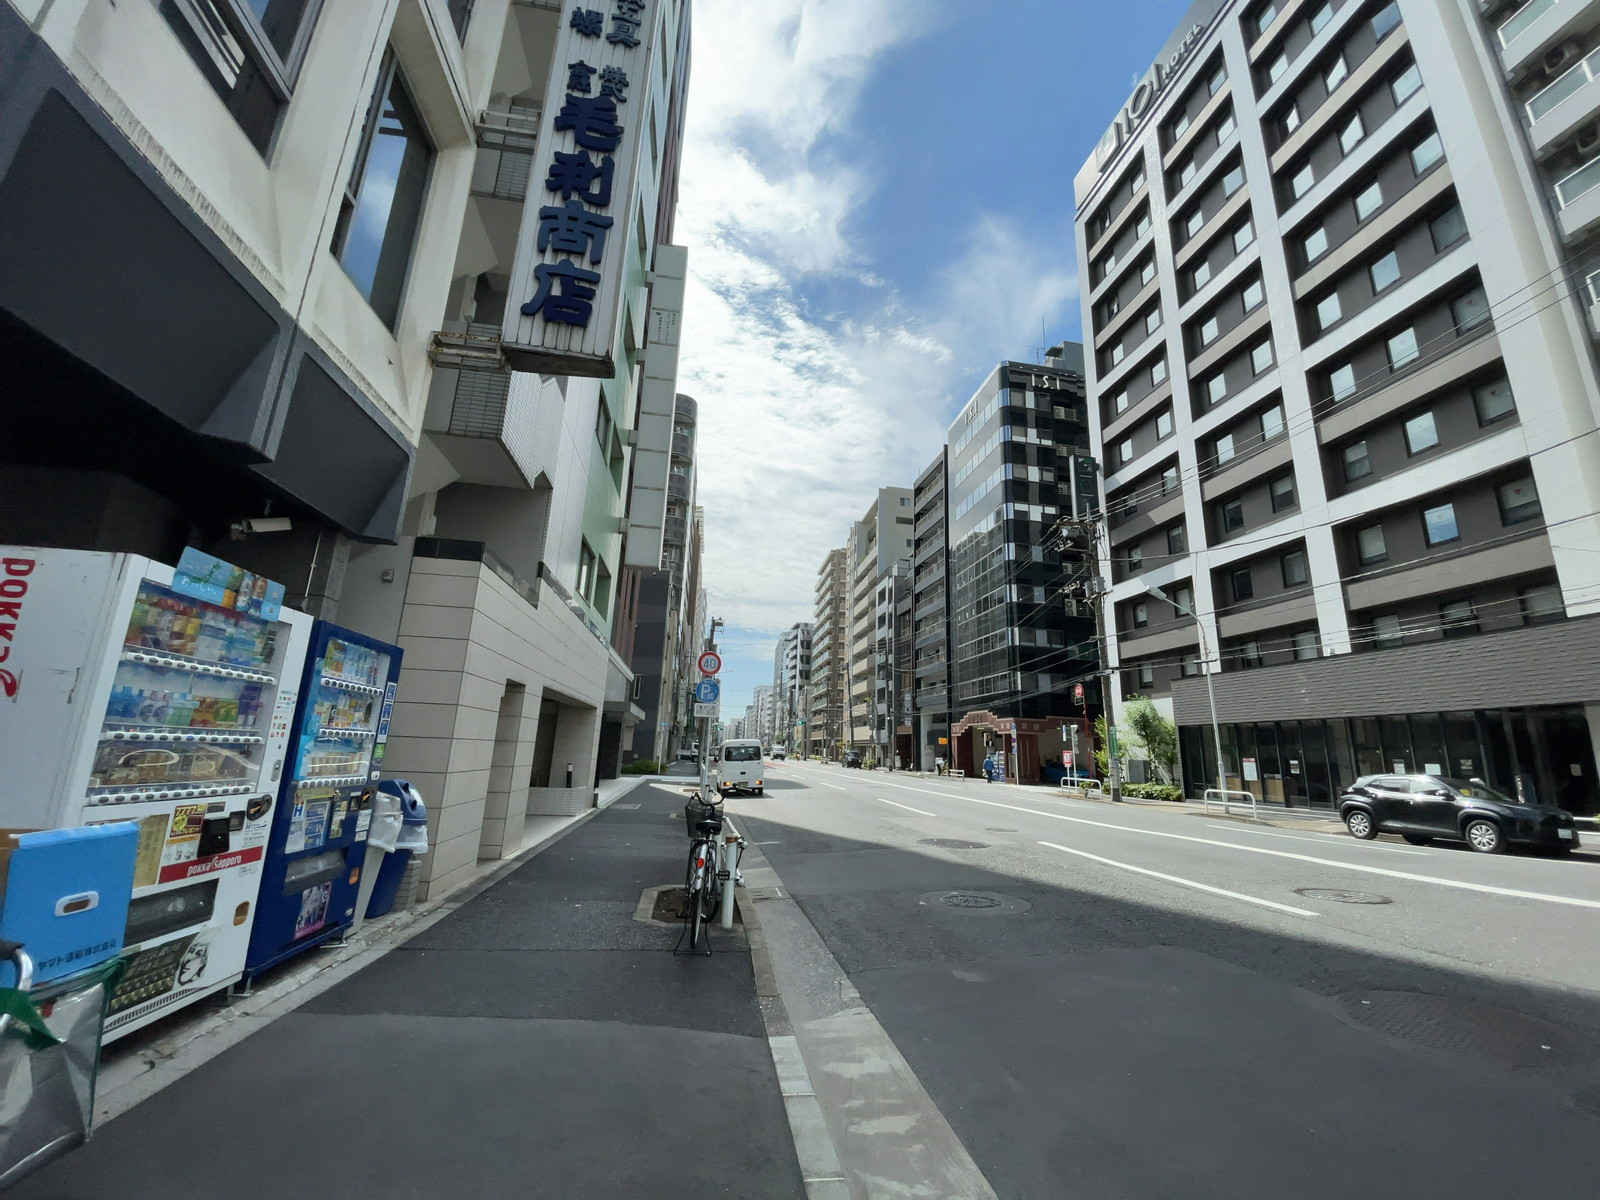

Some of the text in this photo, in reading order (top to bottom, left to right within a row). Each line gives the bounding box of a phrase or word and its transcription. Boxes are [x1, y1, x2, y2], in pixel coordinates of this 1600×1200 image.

[1163, 23, 1203, 80] HOTEL
[520, 93, 624, 328] 毛利商店
[703, 658, 717, 669] 40
[700, 684, 711, 699] P
